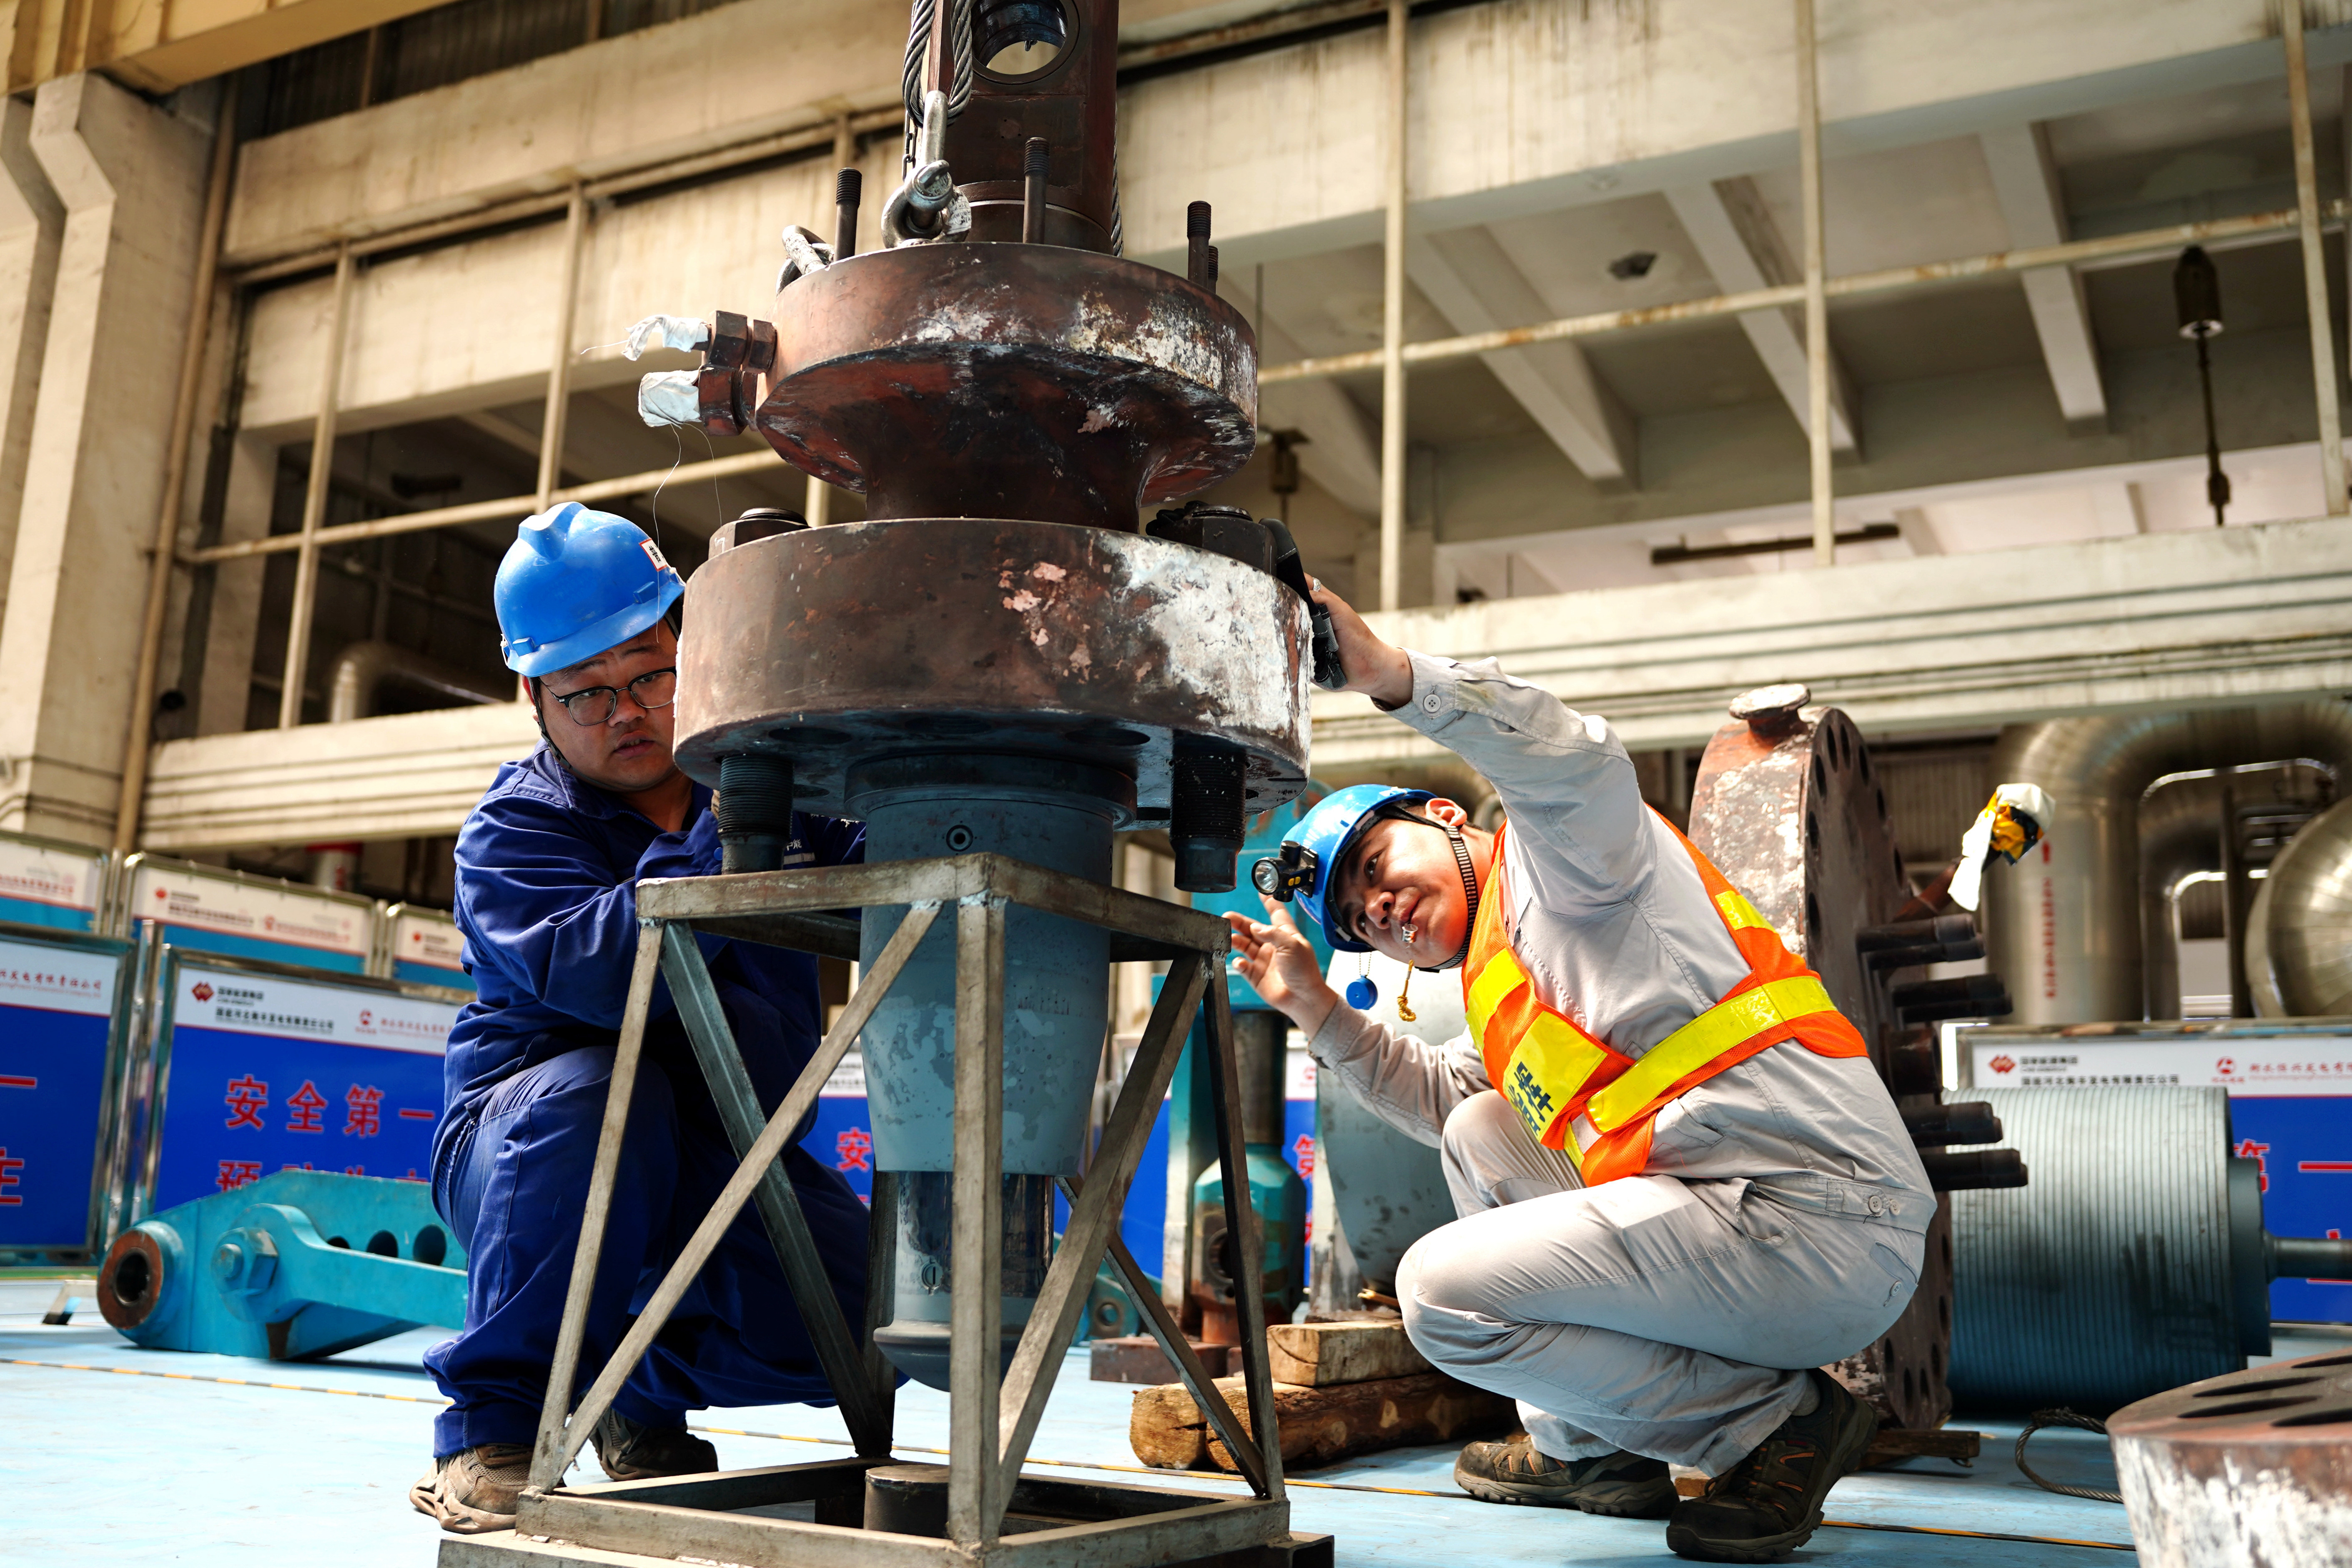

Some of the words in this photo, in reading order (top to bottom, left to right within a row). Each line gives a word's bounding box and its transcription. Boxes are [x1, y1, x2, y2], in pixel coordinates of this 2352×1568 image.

[225, 1074, 435, 1137] 安全第一
[836, 1127, 872, 1173] 安
